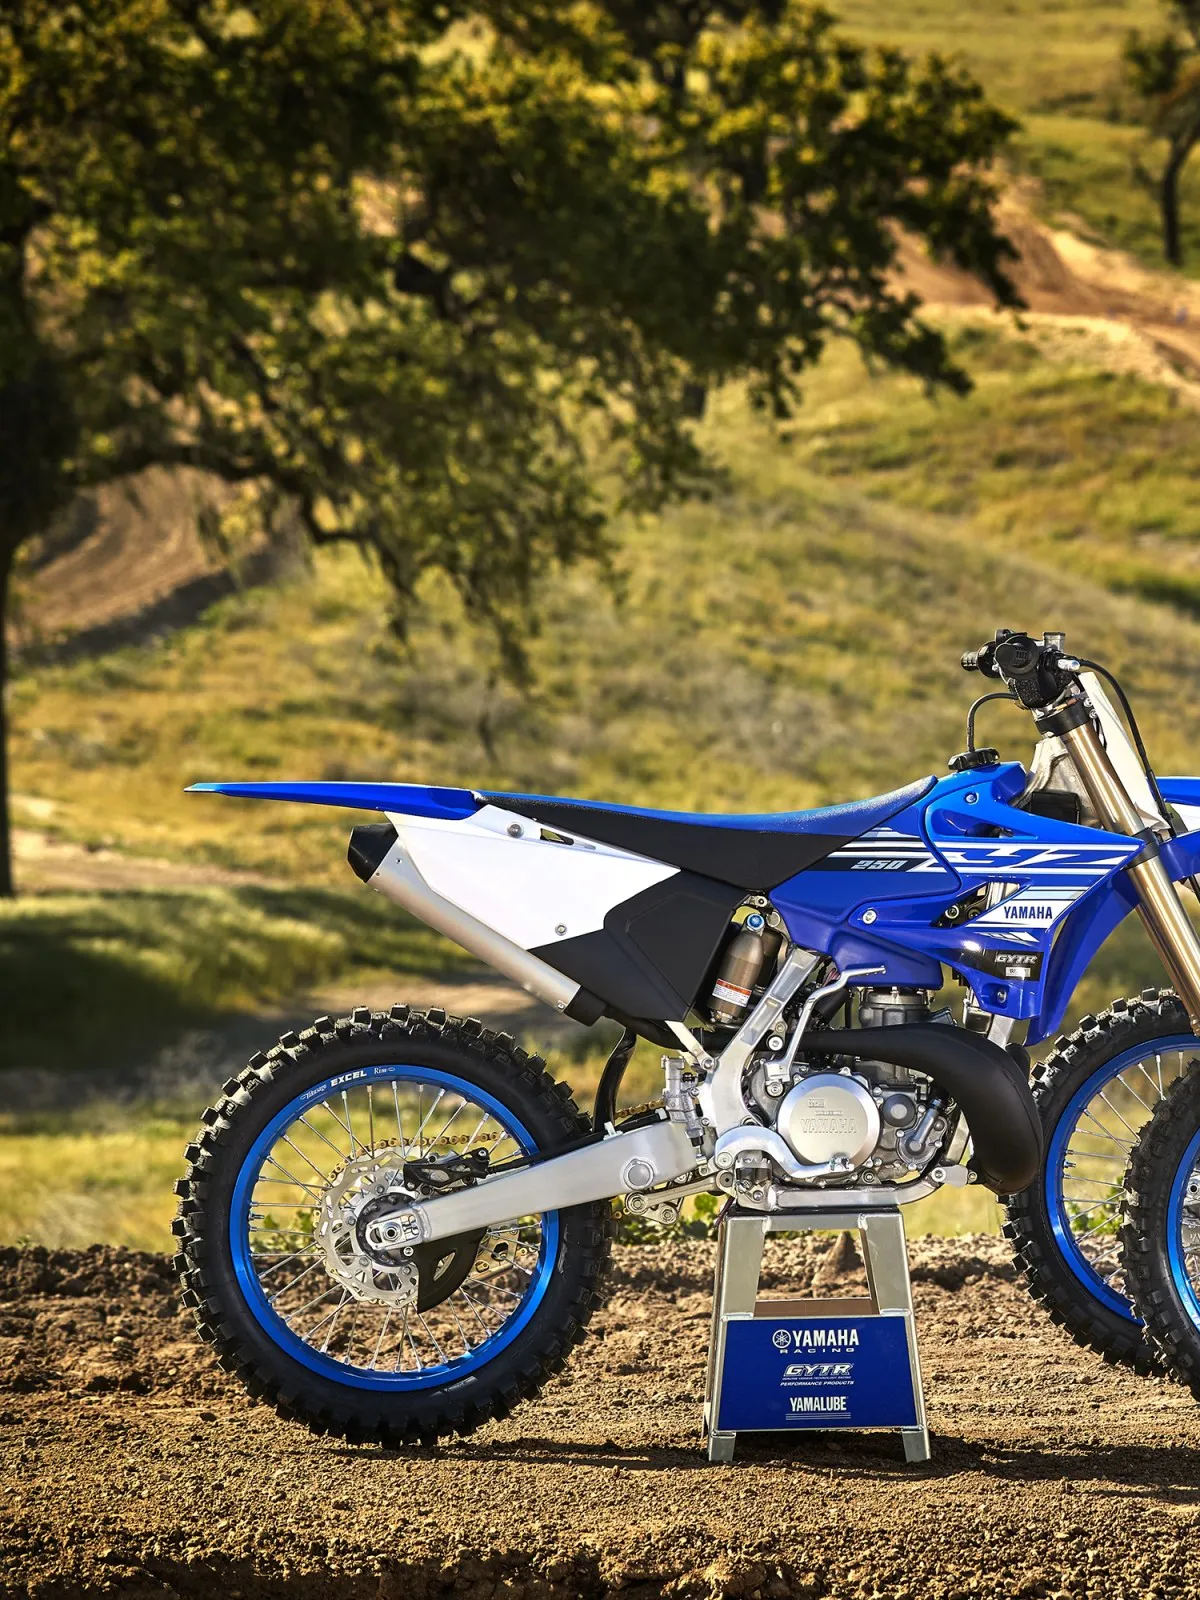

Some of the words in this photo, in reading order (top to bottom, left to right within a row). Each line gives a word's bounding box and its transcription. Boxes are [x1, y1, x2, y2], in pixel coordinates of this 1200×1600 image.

[850, 859, 909, 870] 250
[1003, 905, 1053, 919] YAMAHA
[994, 953, 1038, 964] GYTR
[330, 1070, 368, 1087] EXCEL
[800, 1118, 857, 1134] YAMAHA
[791, 1328, 860, 1347] YAMAHA
[783, 1362, 854, 1377] GYTR
[789, 1396, 847, 1412] YAMALUBE
